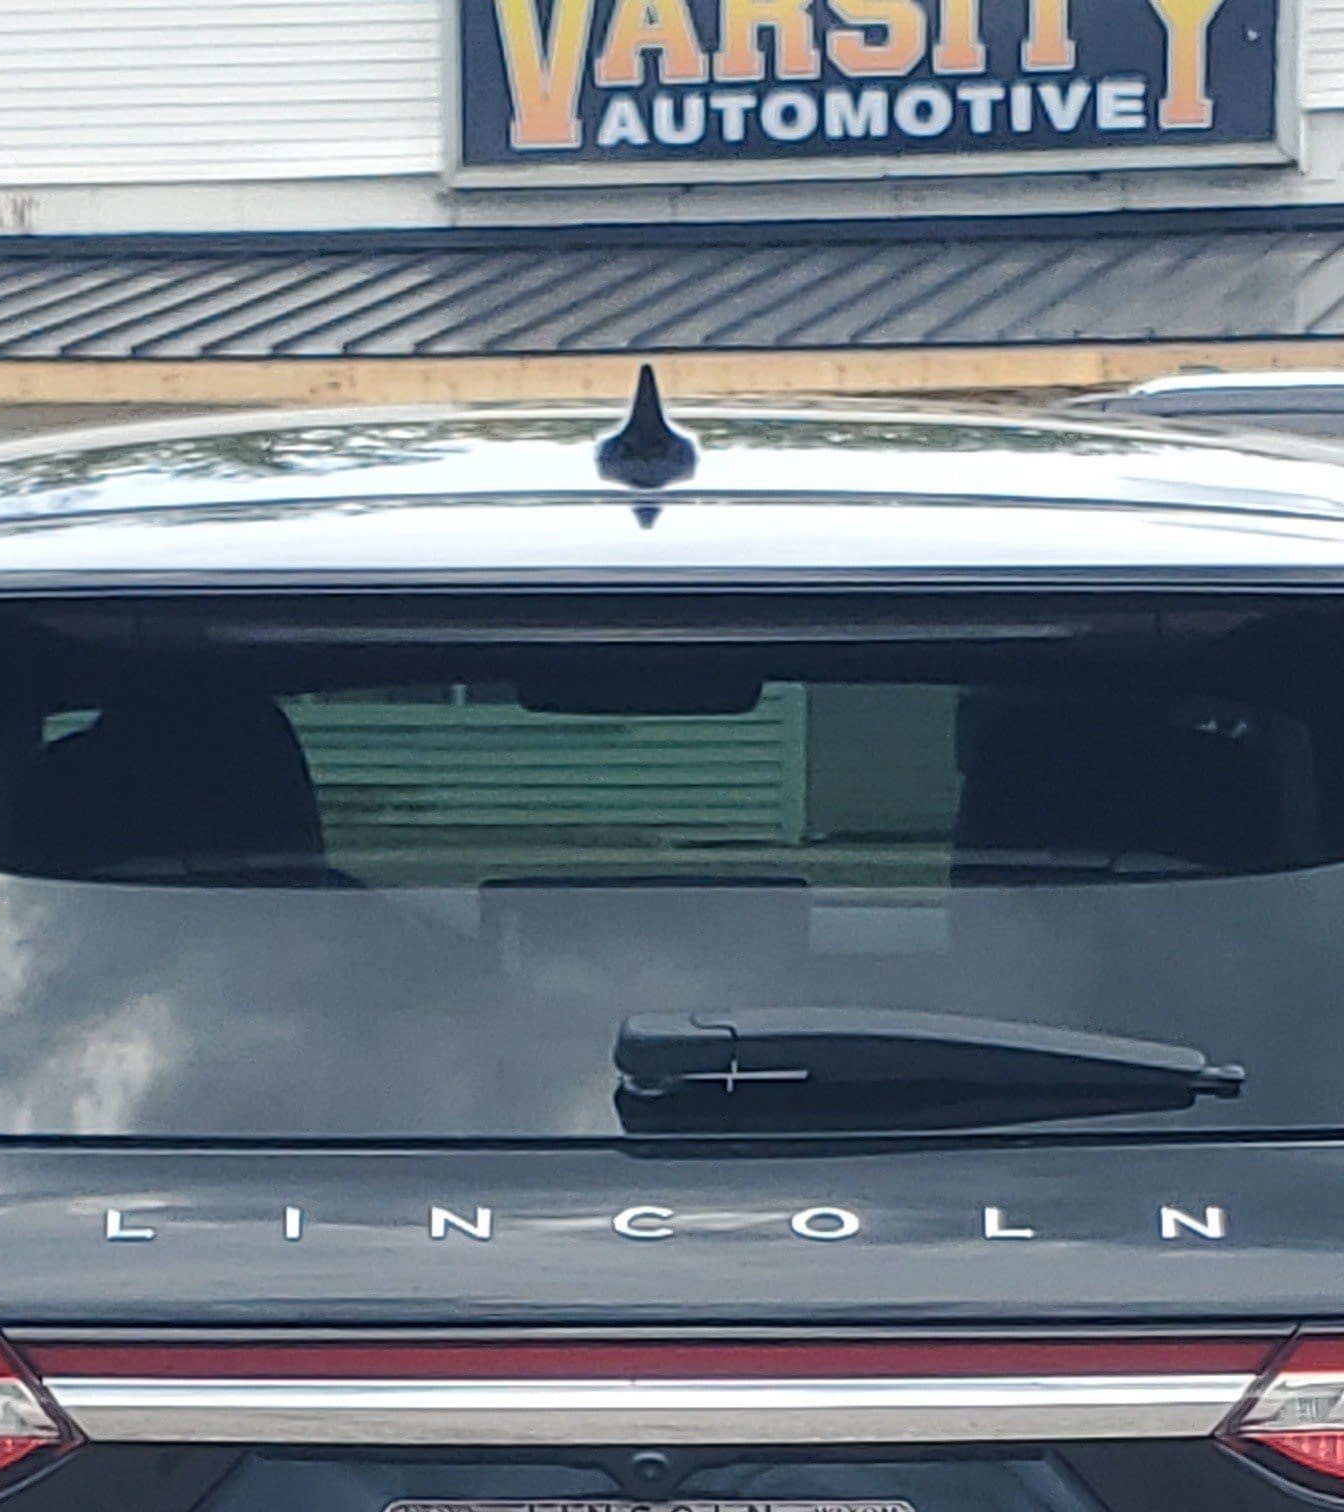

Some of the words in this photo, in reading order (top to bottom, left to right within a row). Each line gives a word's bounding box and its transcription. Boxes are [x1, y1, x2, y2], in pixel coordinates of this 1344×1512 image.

[494, 0, 1223, 149] VARSITY
[597, 80, 1147, 146] AUTOMOTIVE
[105, 1206, 1225, 1241] LINCOLN
